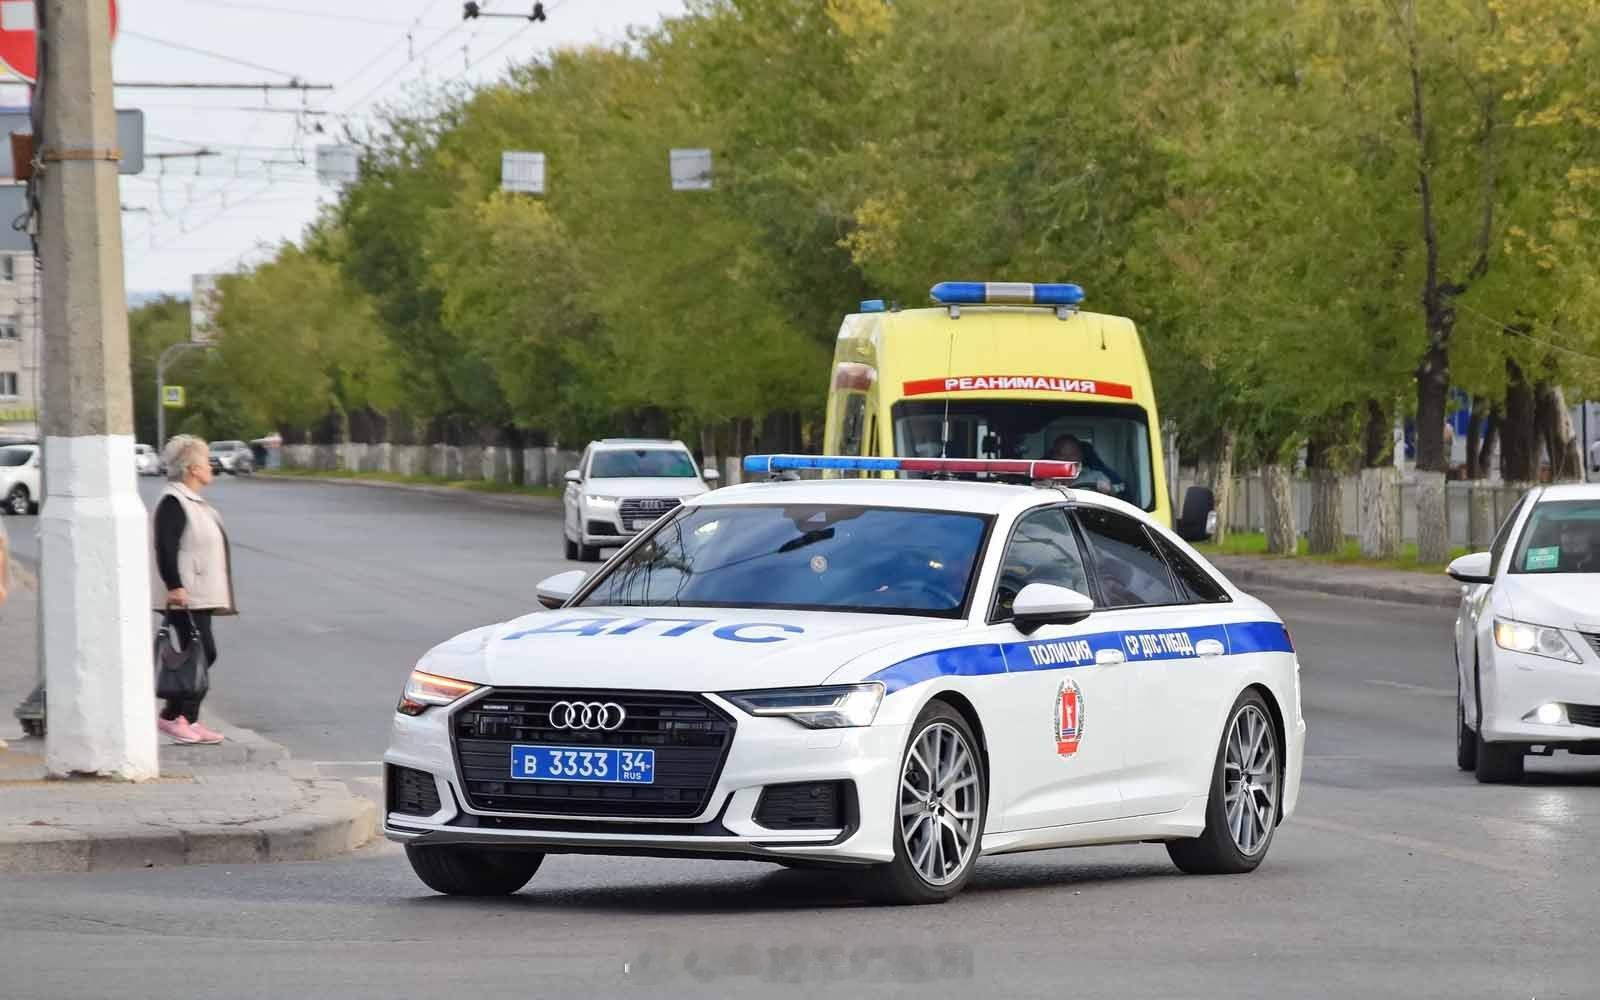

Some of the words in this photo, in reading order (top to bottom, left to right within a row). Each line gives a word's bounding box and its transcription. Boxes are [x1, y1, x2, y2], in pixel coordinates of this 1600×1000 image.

[944, 377, 1096, 393] РЕАНИМАЦИЯ
[501, 617, 805, 643] ДПС
[1028, 640, 1093, 666] ПОЛИЦИЯ
[1124, 635, 1140, 656] СР
[1141, 633, 1162, 658] ДПС
[1159, 632, 1196, 656] ГИБДД
[524, 755, 537, 774] В
[549, 750, 608, 777] 3333
[621, 752, 646, 772] 34
[623, 771, 642, 780] RUS
